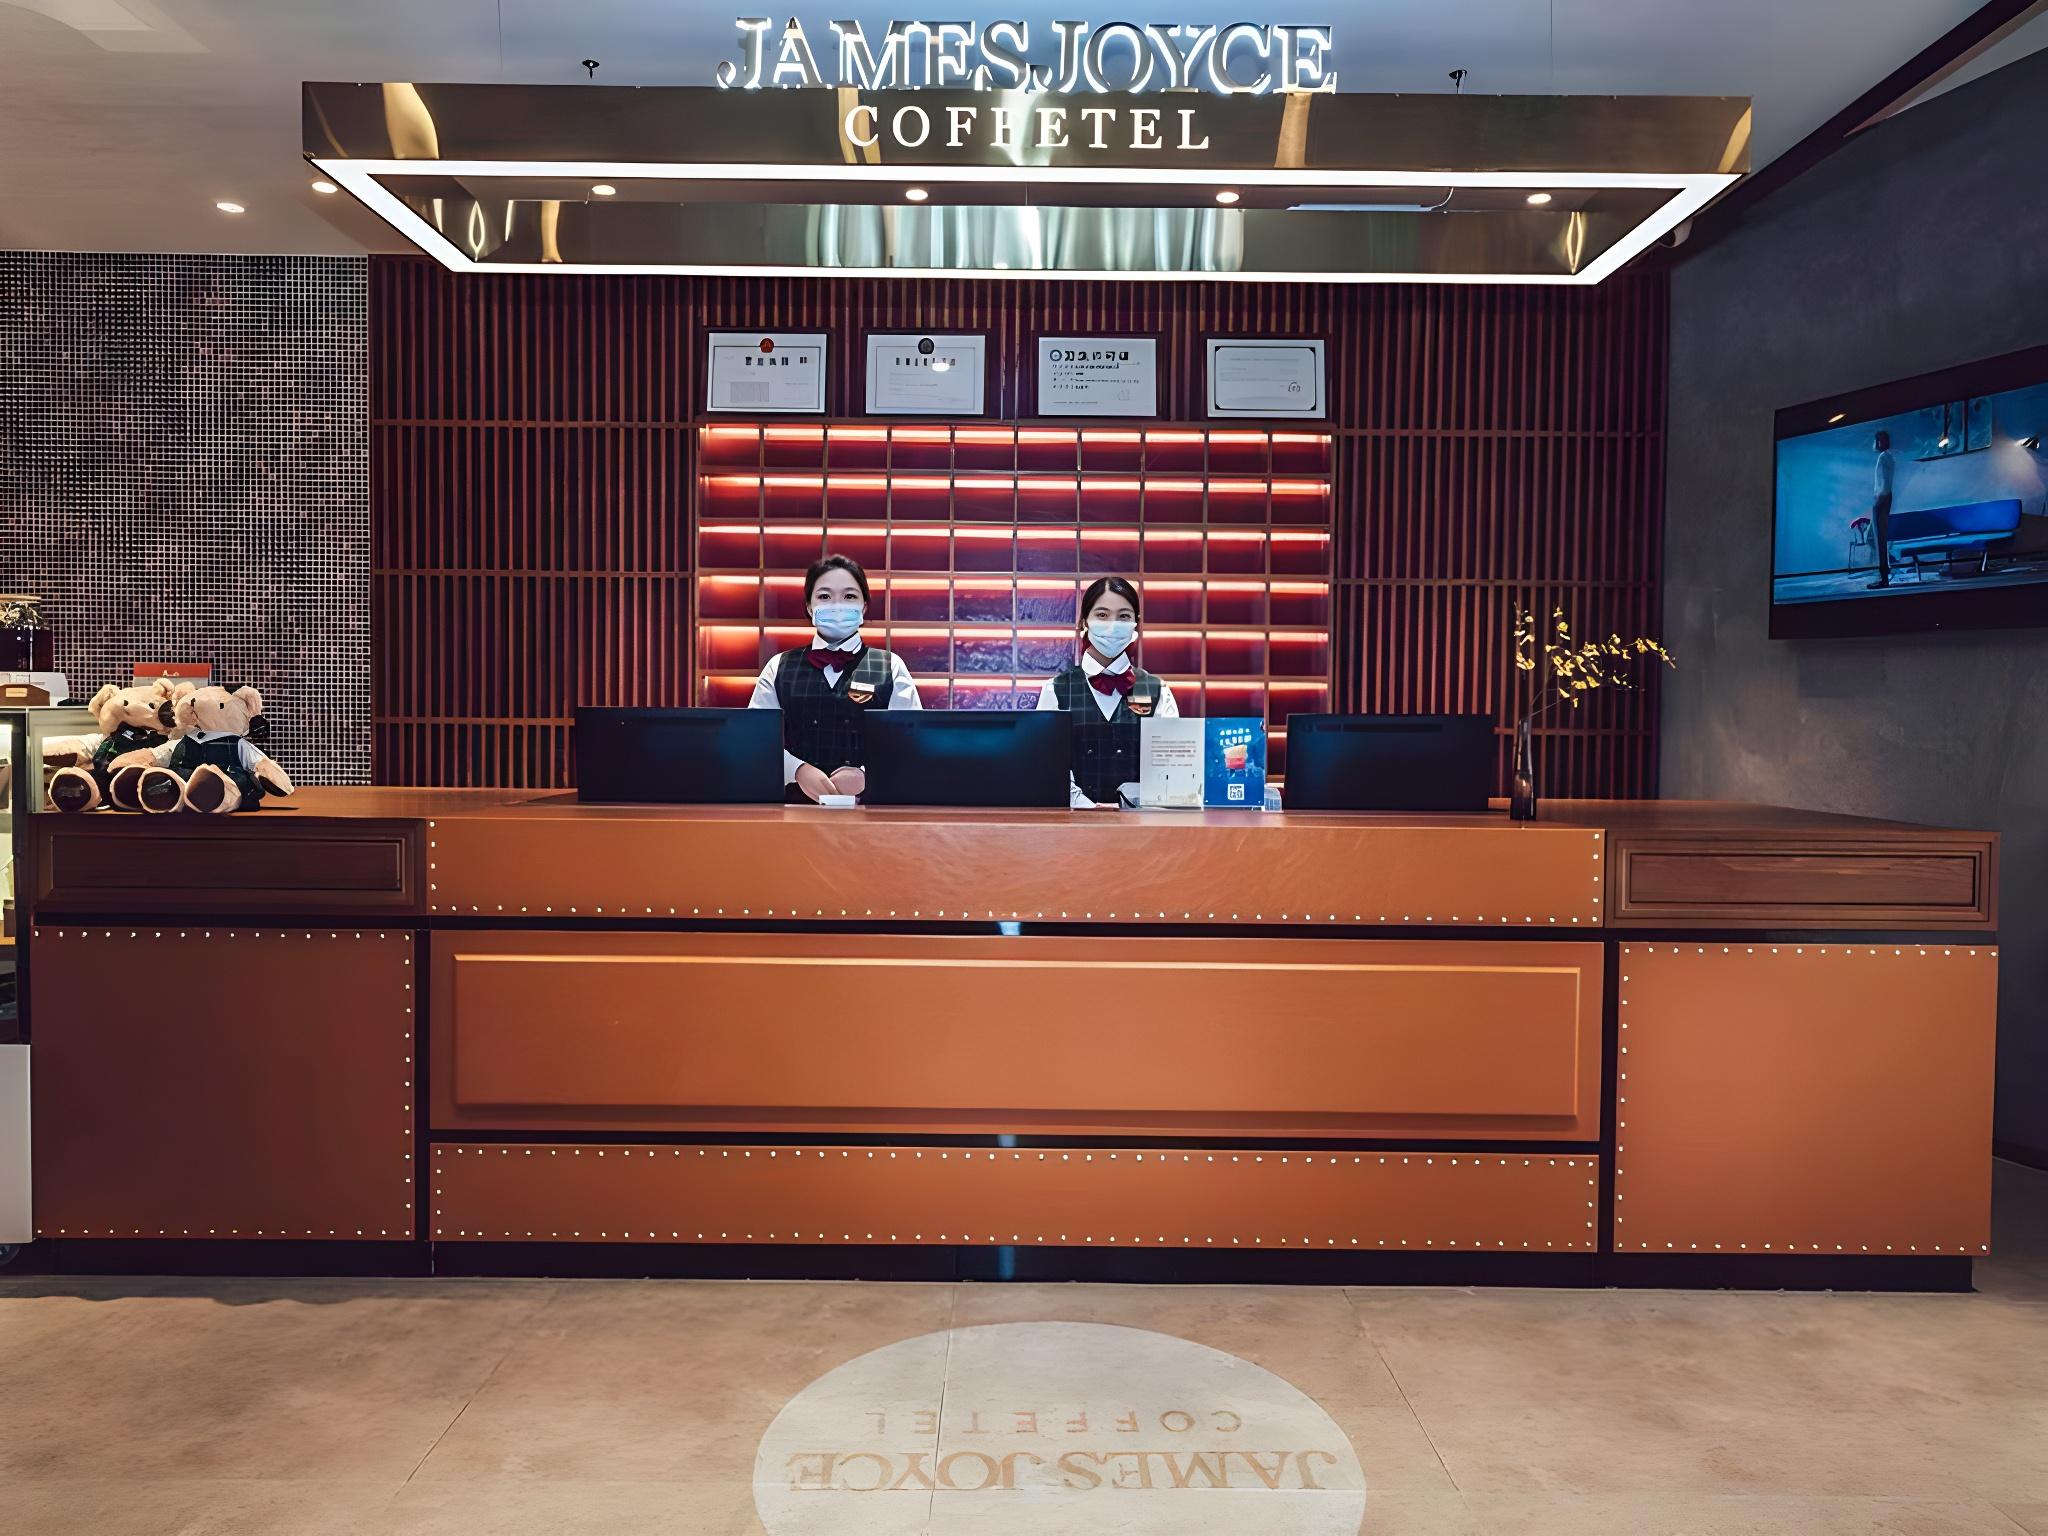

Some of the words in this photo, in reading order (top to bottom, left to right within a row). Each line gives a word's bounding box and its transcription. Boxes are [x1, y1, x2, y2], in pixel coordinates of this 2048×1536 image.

[716, 16, 1029, 92] JAMES
[1026, 19, 1338, 94] JOYCE
[864, 1409, 1243, 1435] COFFETEL
[785, 1451, 1045, 1492] JOYCE
[1057, 1449, 1338, 1492] JAMES
